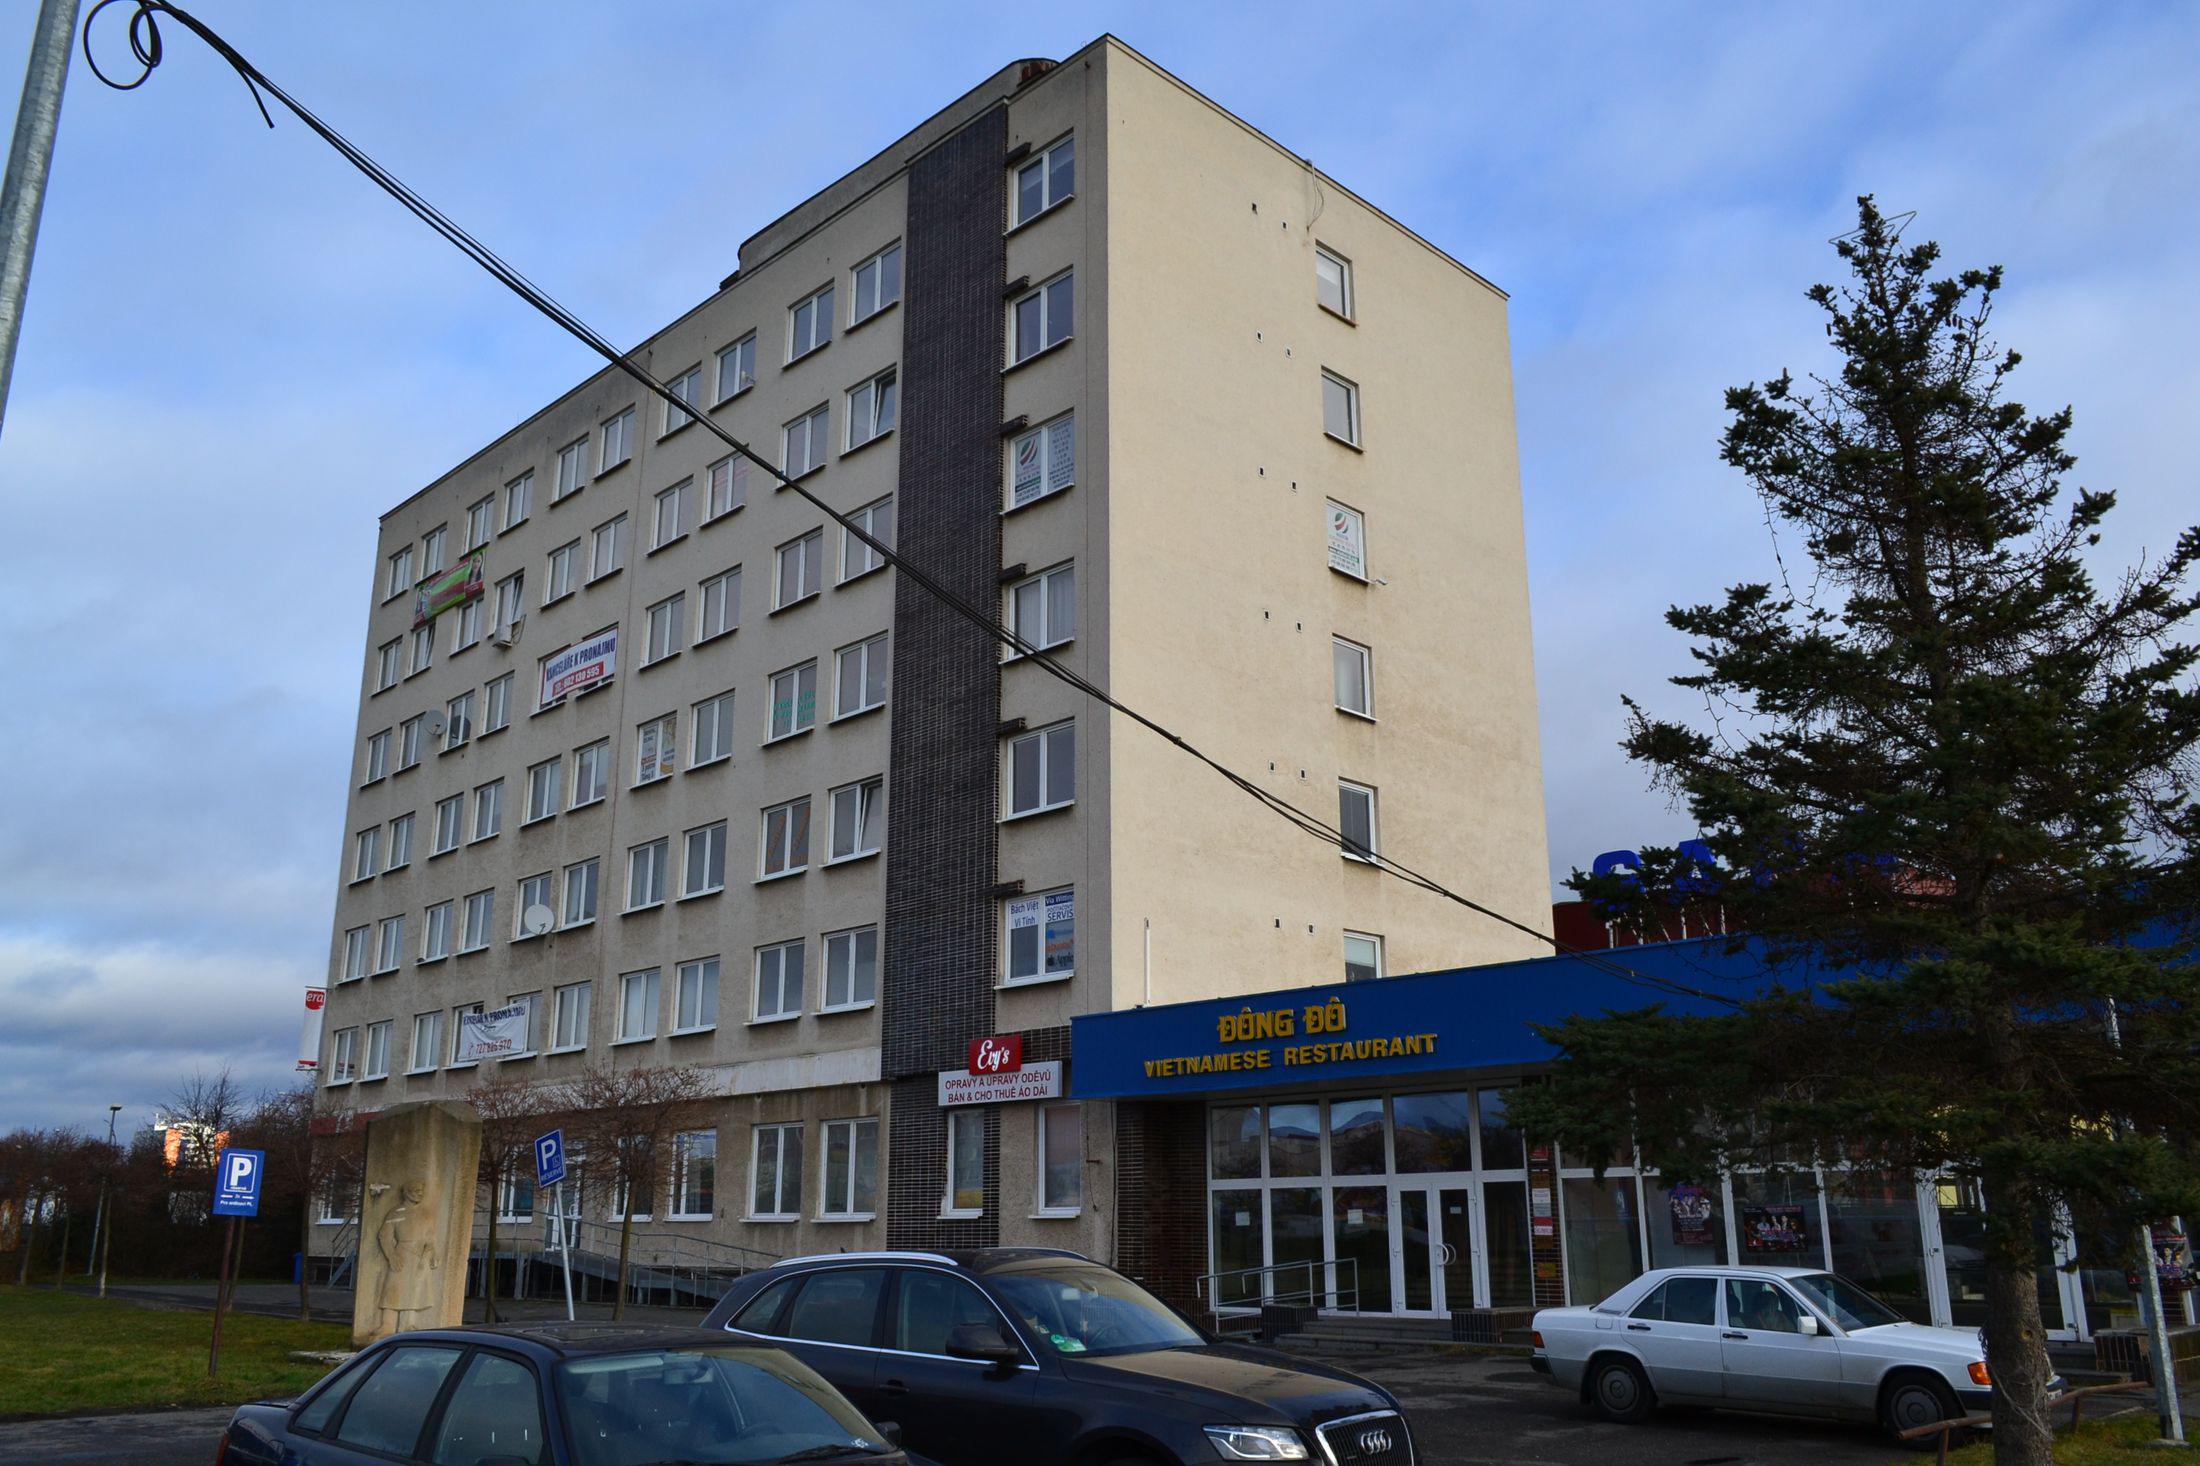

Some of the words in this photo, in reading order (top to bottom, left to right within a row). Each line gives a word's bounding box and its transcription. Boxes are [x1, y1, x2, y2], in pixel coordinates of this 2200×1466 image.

[1047, 910, 1074, 922] SERVIS
[306, 993, 324, 1003] era
[977, 1040, 1010, 1072] Evy's
[1144, 1049, 1272, 1078] VIETNAMESE
[1284, 1033, 1438, 1067] RESTAURANT
[945, 1078, 977, 1090] OPRAVY
[979, 1077, 985, 1087] A
[1021, 1069, 1051, 1083] ODĚVŮ
[967, 1092, 973, 1101] &
[974, 1090, 993, 1101] CHO
[541, 1139, 557, 1170] P
[230, 1157, 252, 1186] P
